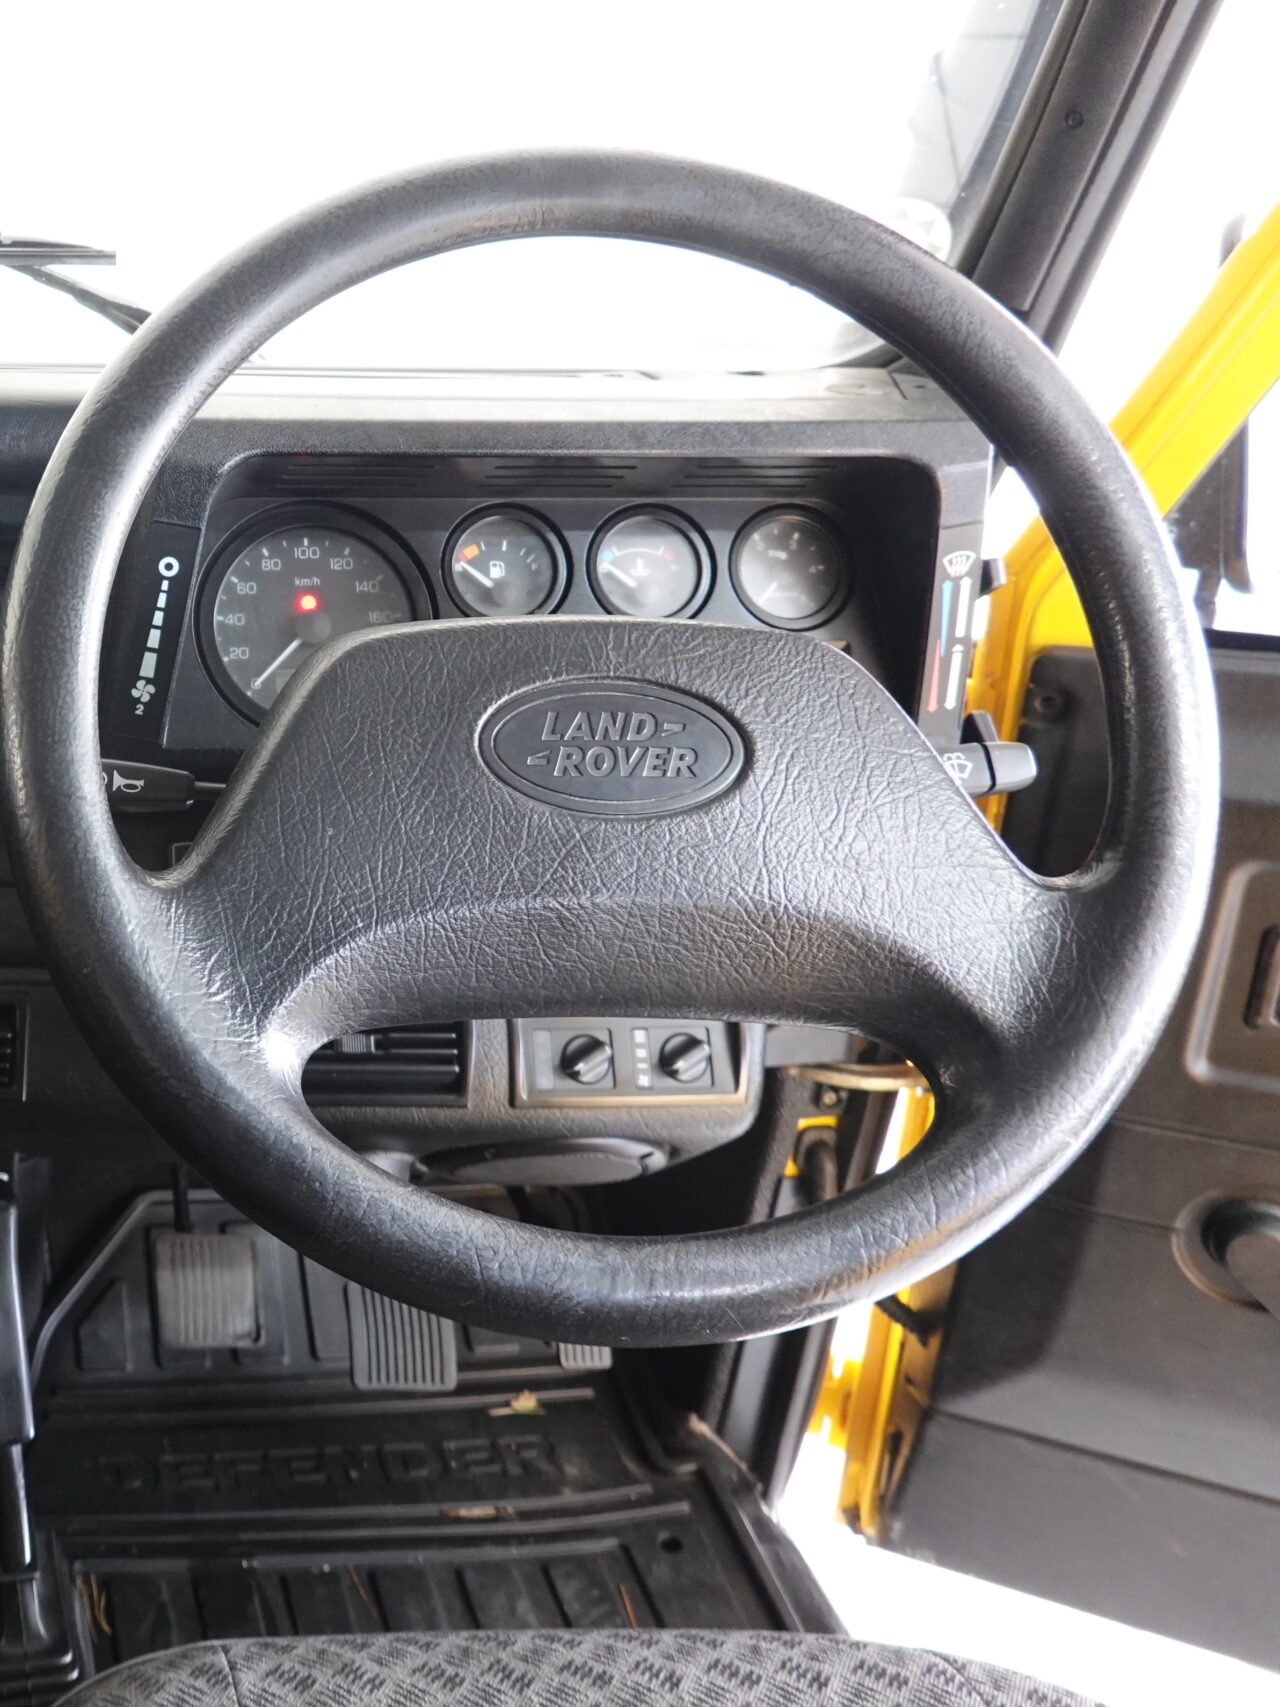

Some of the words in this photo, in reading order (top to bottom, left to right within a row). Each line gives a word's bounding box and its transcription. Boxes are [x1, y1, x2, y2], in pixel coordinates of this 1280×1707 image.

[294, 547, 320, 559] 100
[261, 559, 282, 571] 80
[329, 558, 354, 570] 120
[294, 577, 320, 587] km/h
[355, 581, 379, 593] 140
[236, 583, 257, 595] 60
[224, 614, 245, 625] 40
[369, 611, 391, 624] 160
[229, 647, 249, 659] 20
[134, 703, 145, 715] 2
[541, 711, 658, 741] LAND
[553, 745, 699, 778] ROVER
[98, 1434, 562, 1489] DEFENDER
